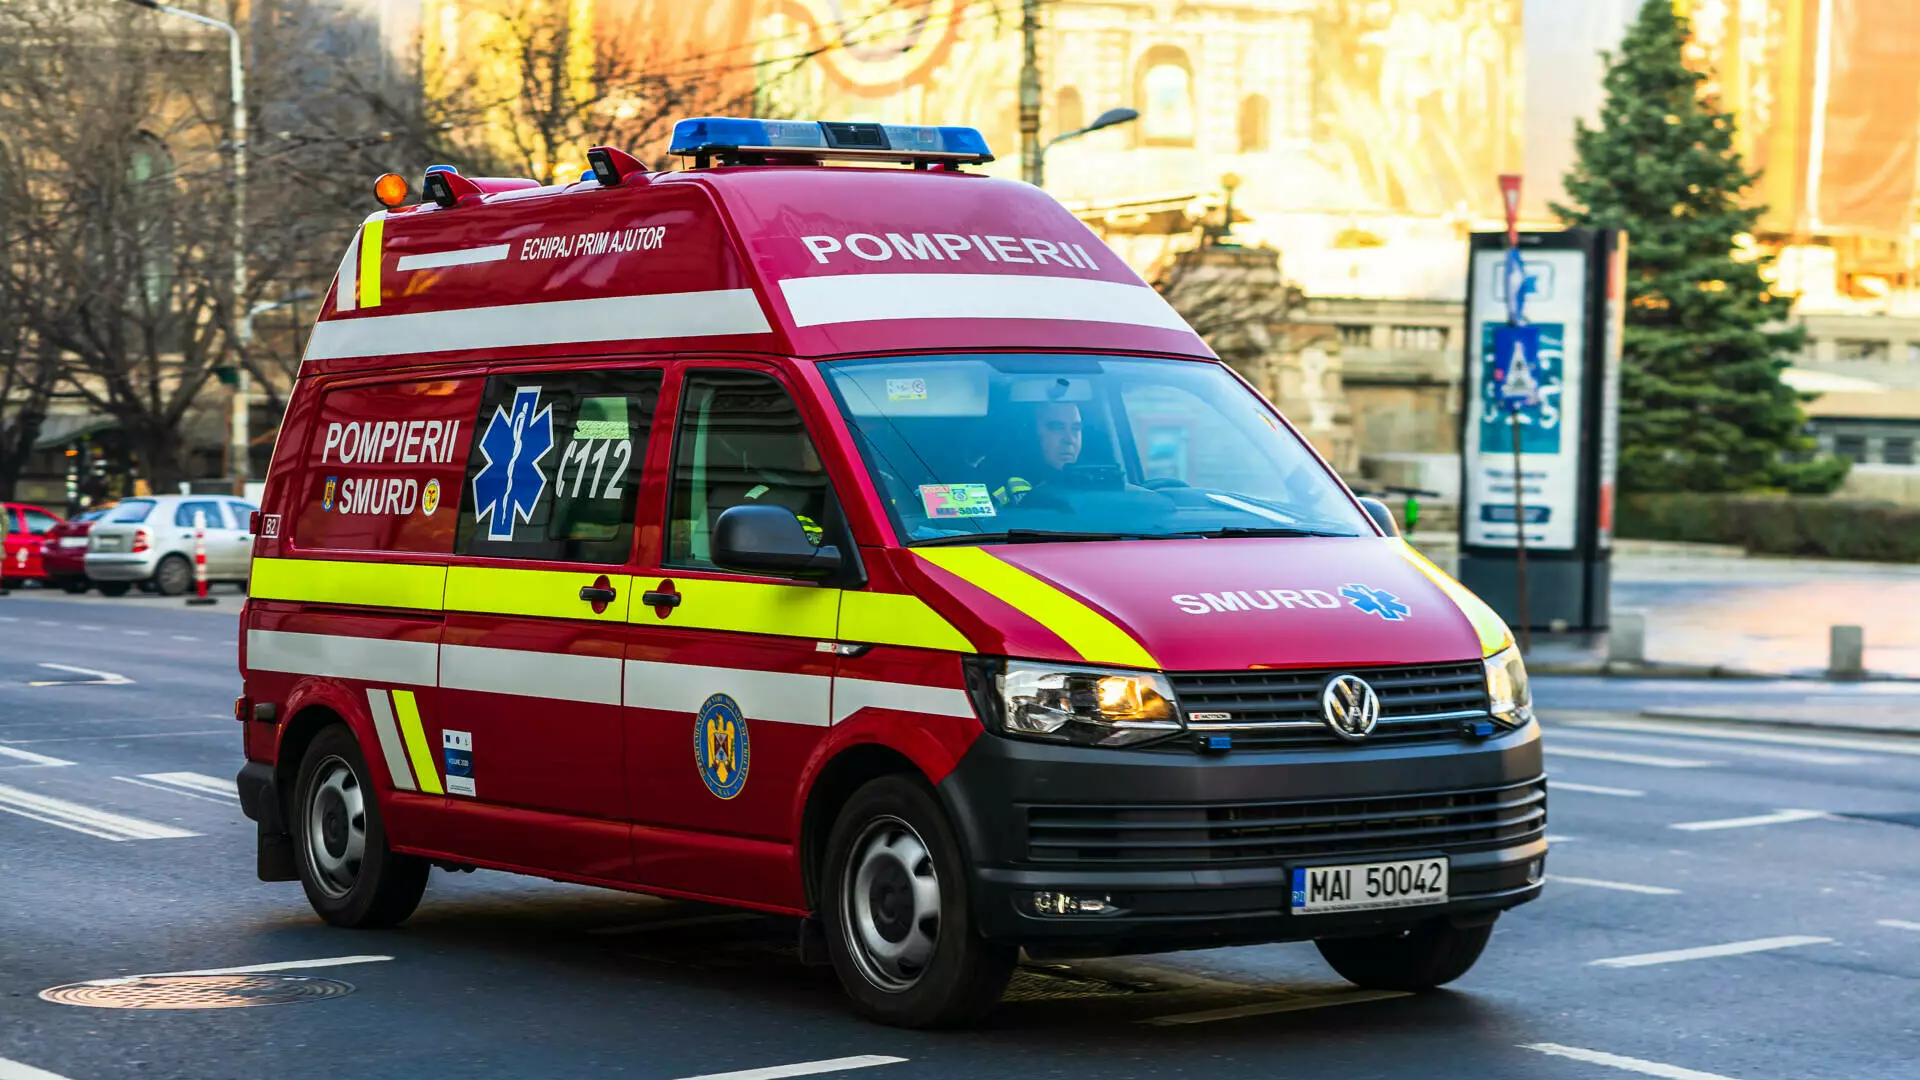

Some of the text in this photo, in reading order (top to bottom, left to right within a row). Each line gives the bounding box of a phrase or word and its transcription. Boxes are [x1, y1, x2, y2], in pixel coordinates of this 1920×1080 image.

[520, 226, 666, 261] ECHIPAJ PRIM AJUTOR
[801, 232, 1101, 271] POMPIERII
[321, 420, 460, 464] POMPIERII
[338, 478, 418, 515] SMURD
[265, 518, 277, 535] B2
[1171, 589, 1342, 615] SMURD
[1310, 869, 1351, 903] MAI
[1366, 862, 1442, 897] 50042
